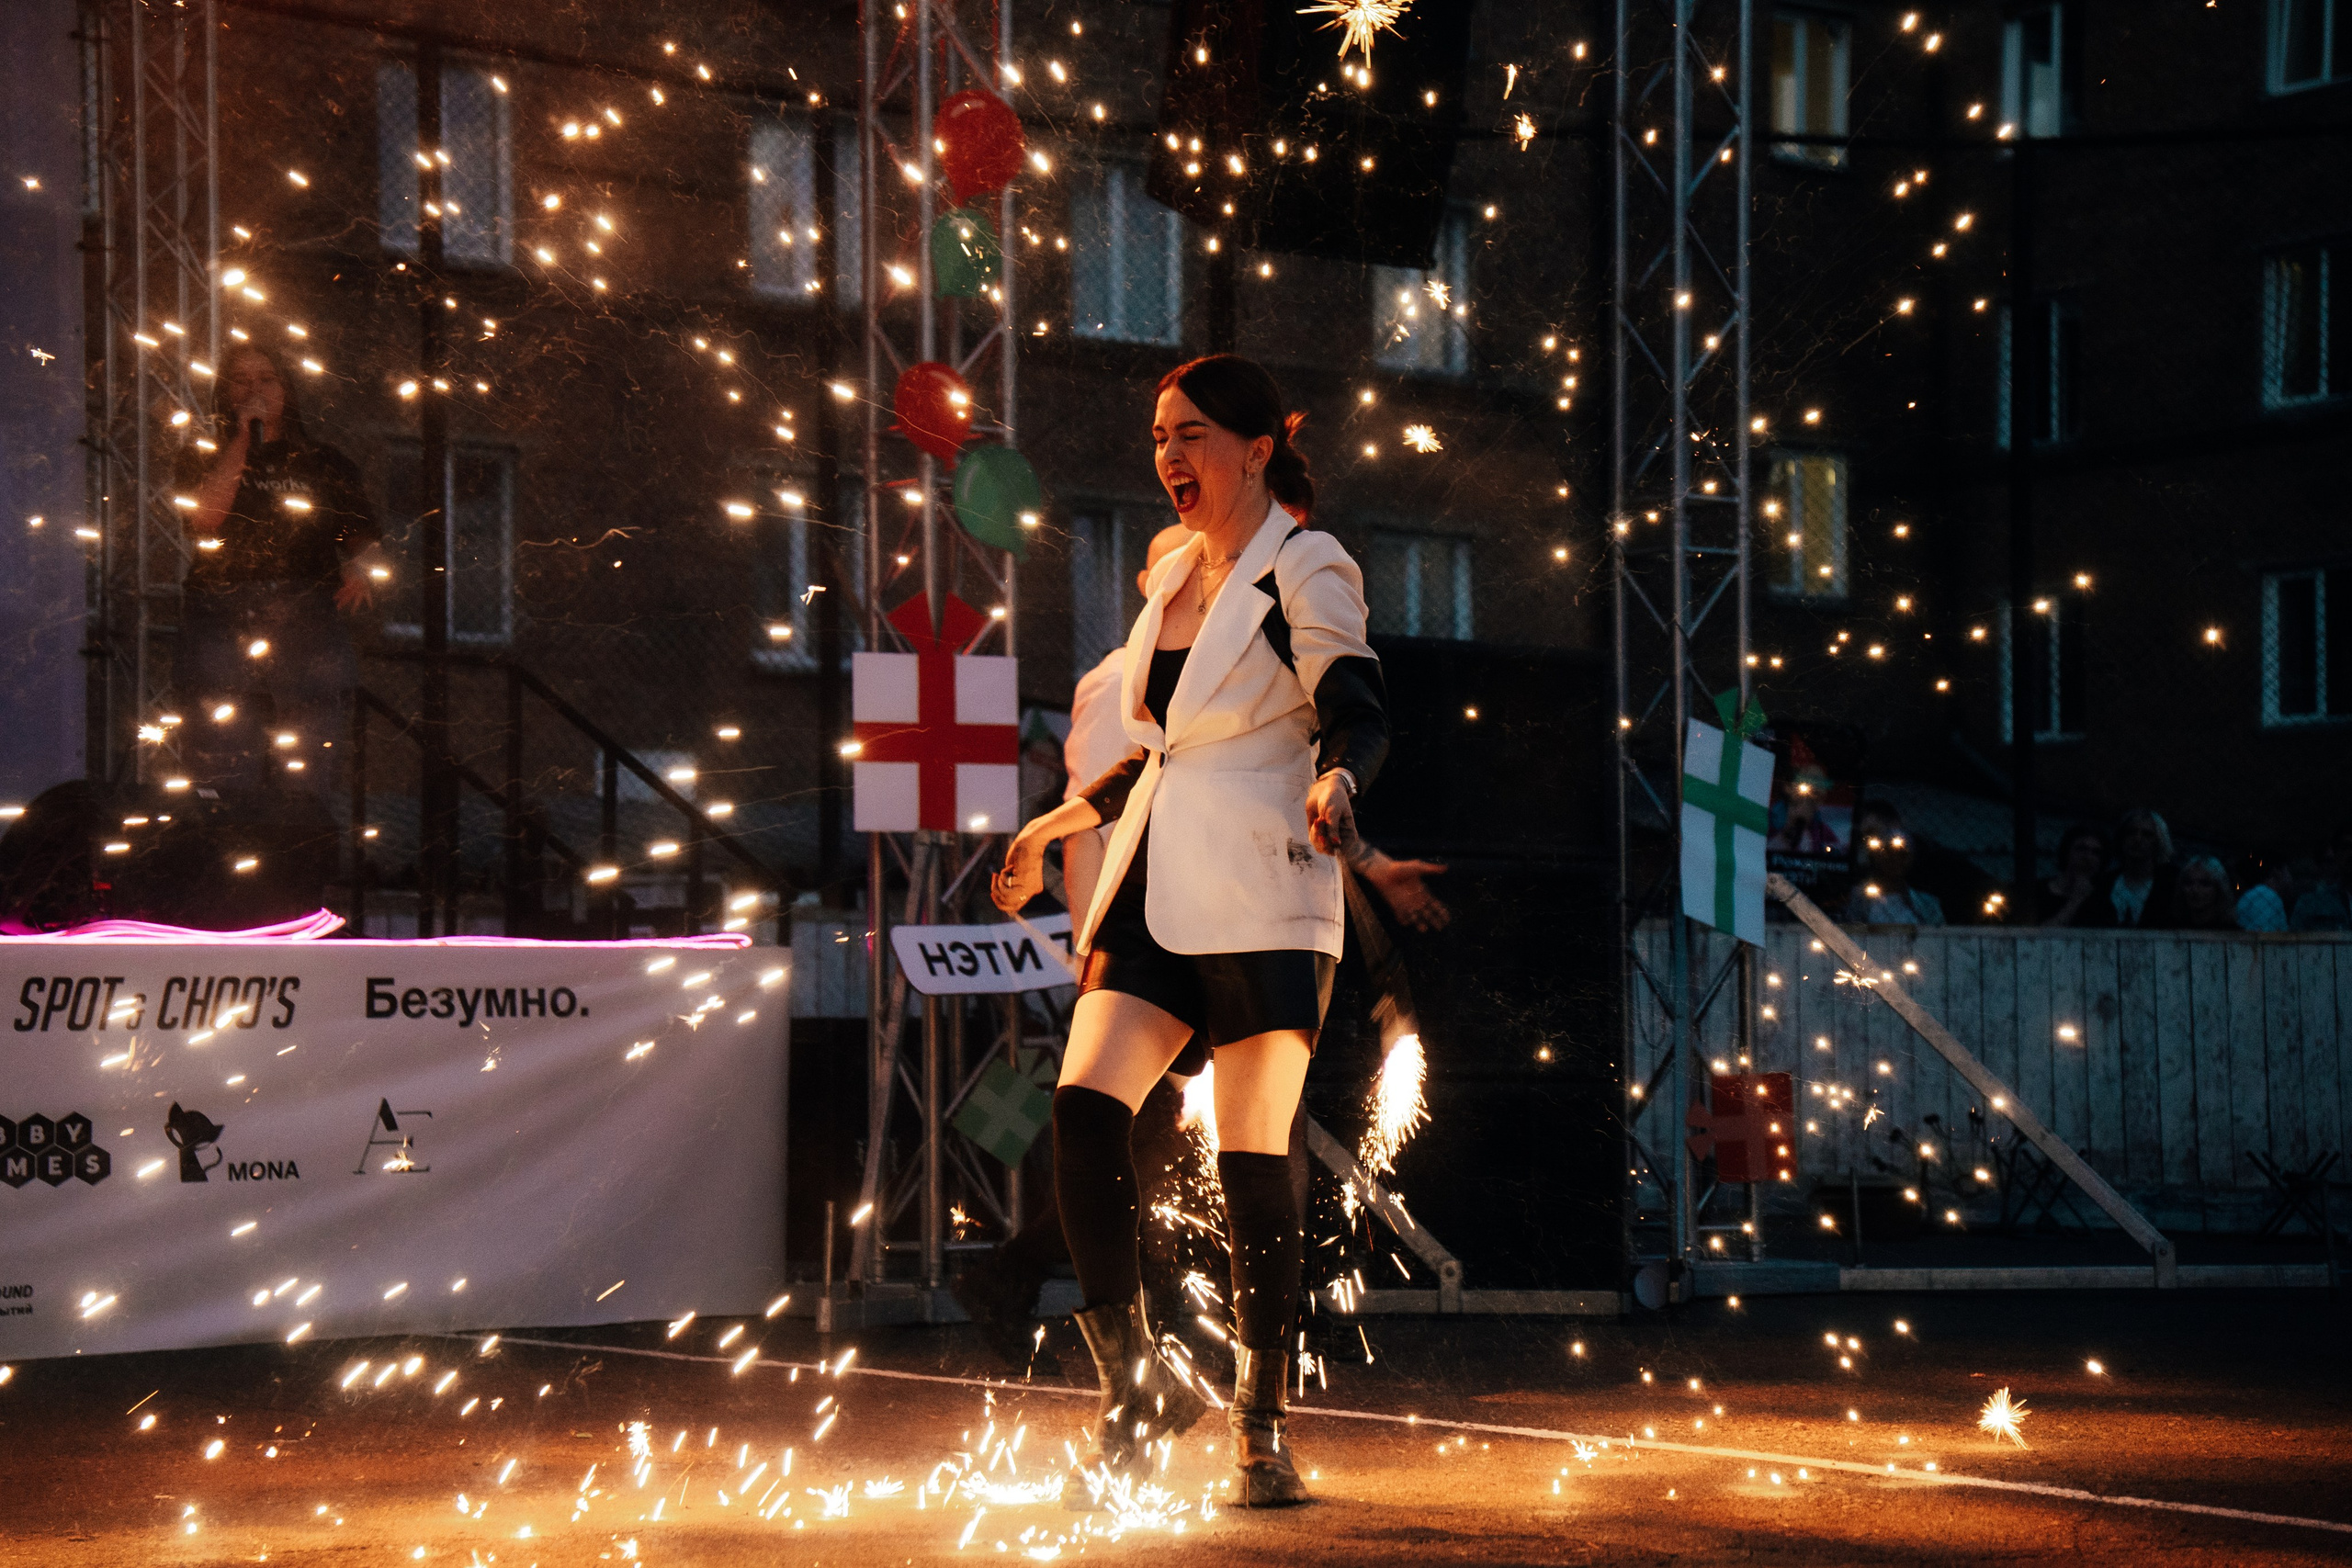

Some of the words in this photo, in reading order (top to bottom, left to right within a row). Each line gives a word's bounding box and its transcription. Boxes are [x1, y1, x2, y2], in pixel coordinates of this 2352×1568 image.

[918, 937, 1044, 976] НЭТИ
[14, 976, 125, 1032] SPOT
[365, 976, 590, 1028] Безумно.
[228, 1159, 300, 1181] MONA
[0, 1284, 34, 1299] UND
